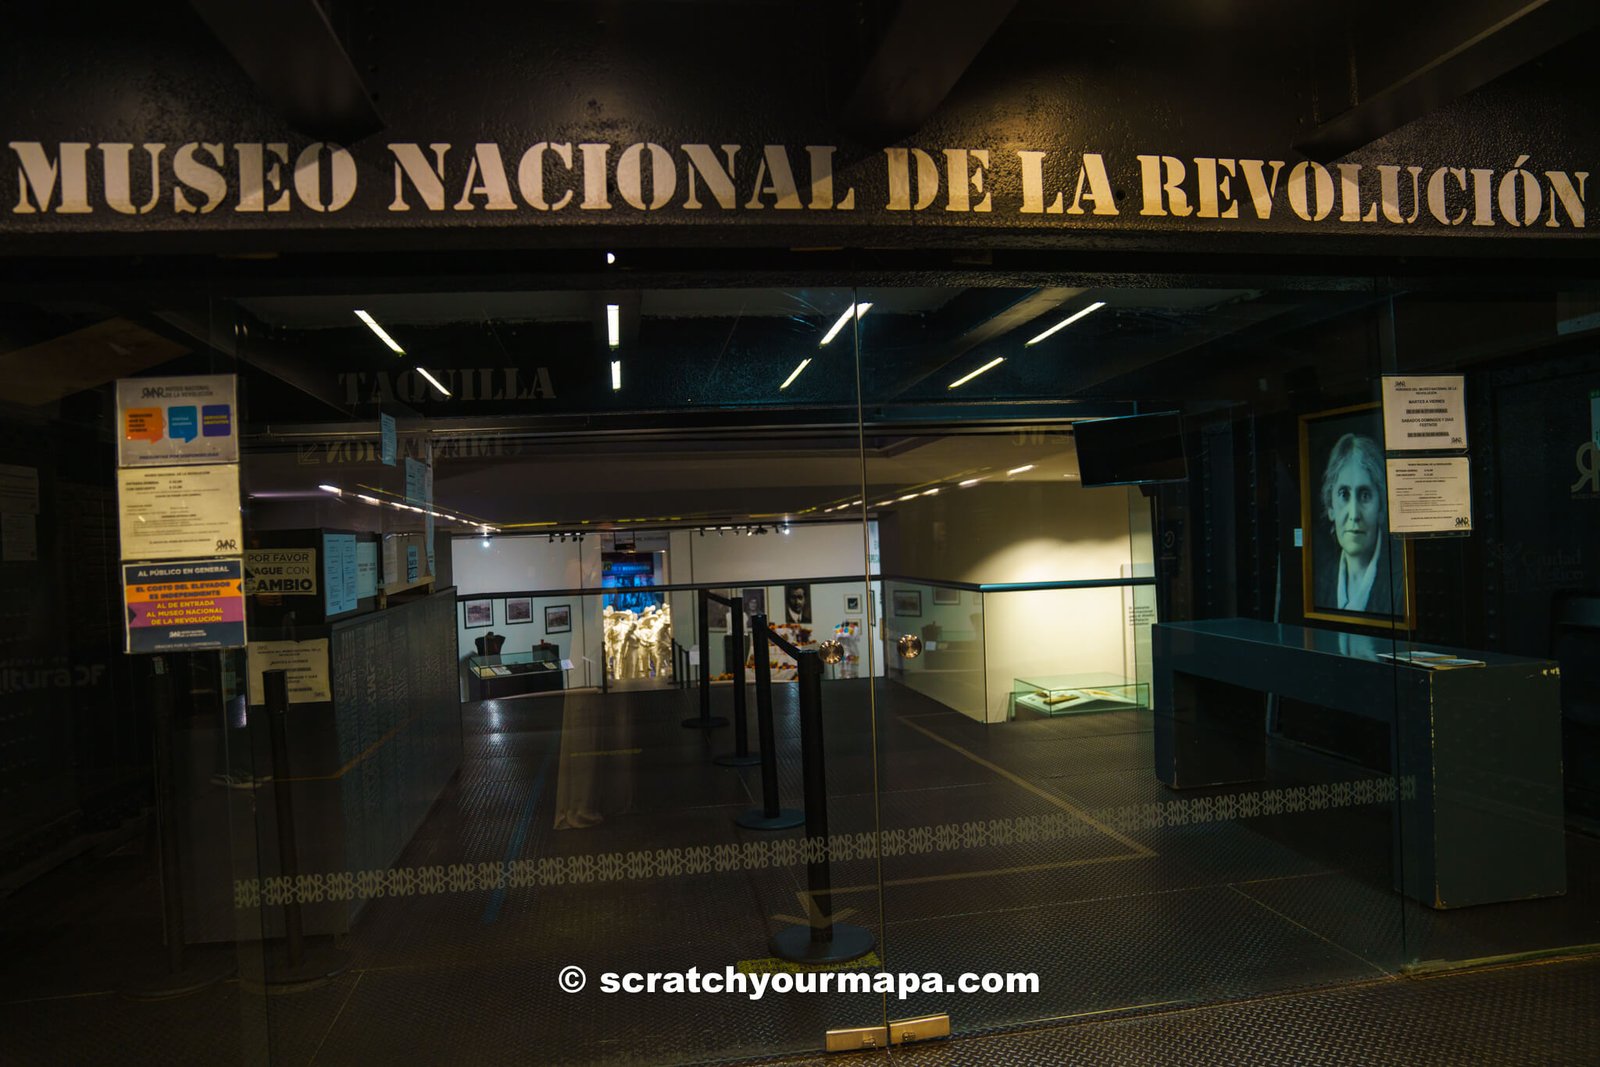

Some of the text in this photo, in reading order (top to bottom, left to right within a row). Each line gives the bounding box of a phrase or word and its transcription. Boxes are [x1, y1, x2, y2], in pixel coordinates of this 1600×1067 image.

[9, 141, 1590, 229] MUSEO NACIONAL DE LA REVOLUCIÓN
[337, 366, 558, 406] TAQUILLA
[249, 553, 310, 563] POR FAVOR
[149, 568, 182, 577] PÚBLICO
[194, 566, 230, 574] GENERAL
[250, 566, 310, 575] AGUE CON
[191, 581, 231, 589] ELEVADOR
[174, 615, 223, 624] REVOLUCIÓN
